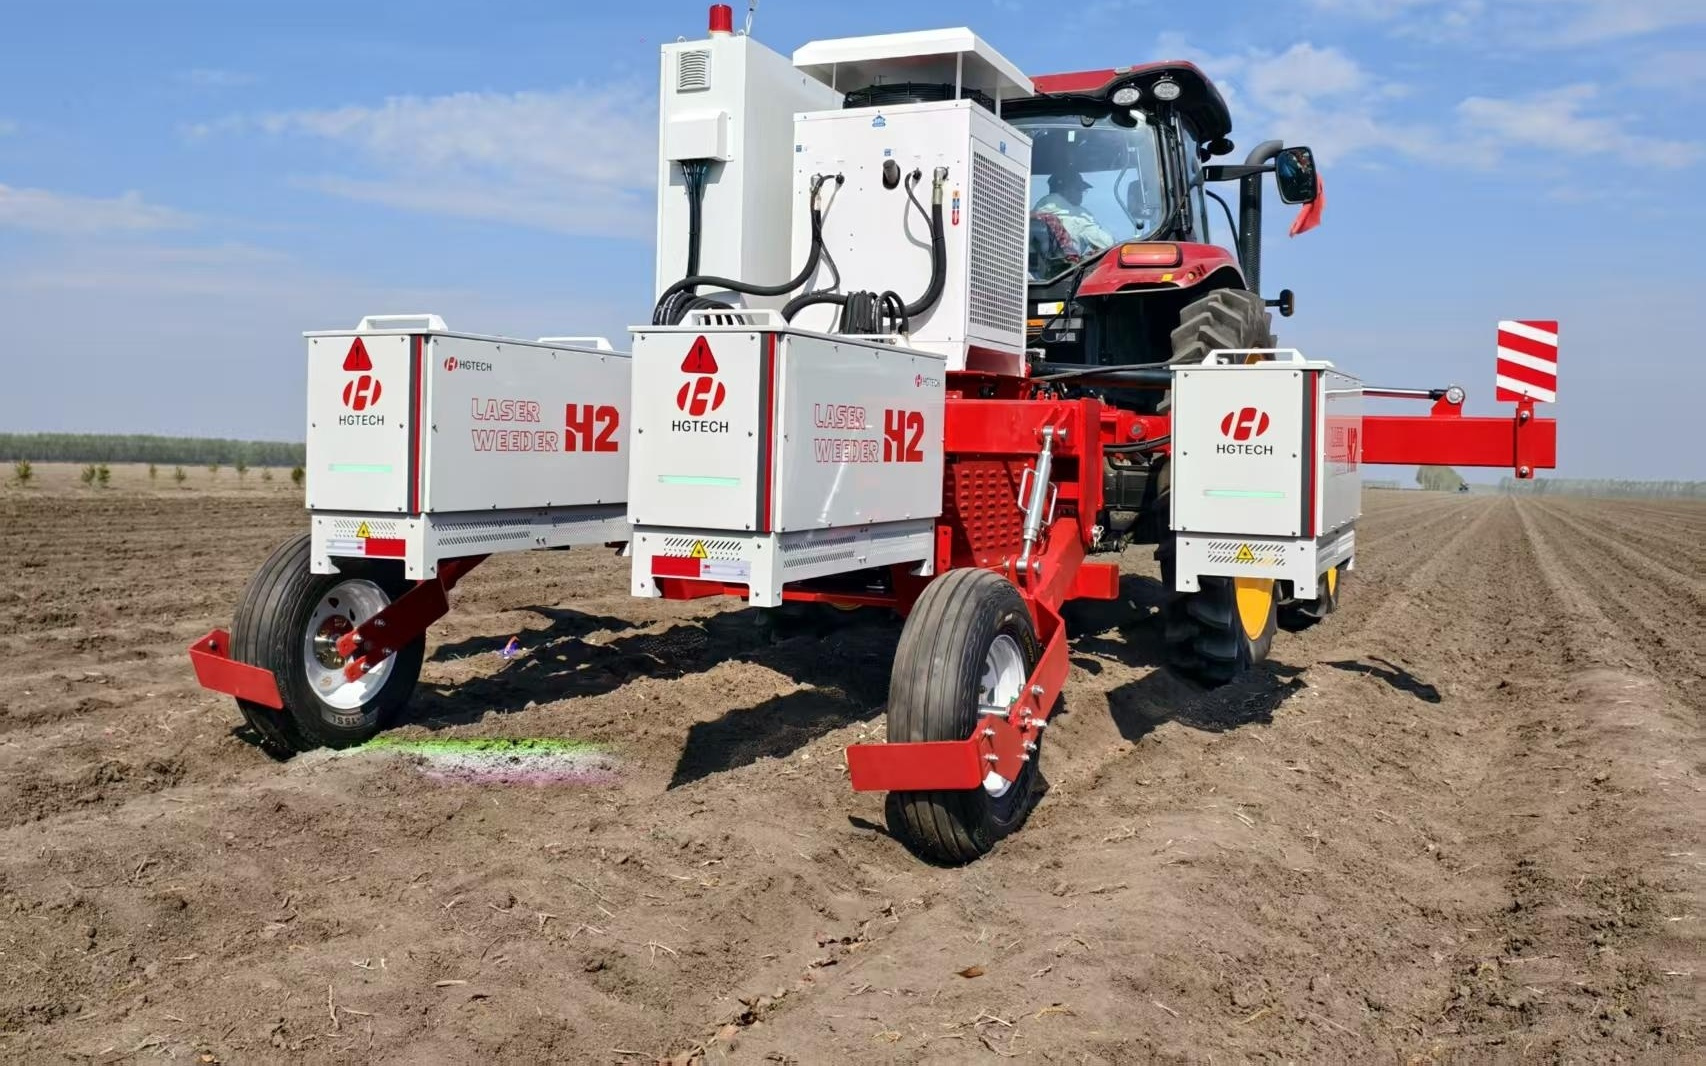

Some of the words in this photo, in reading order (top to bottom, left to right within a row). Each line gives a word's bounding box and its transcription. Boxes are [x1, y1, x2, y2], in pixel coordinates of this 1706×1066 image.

[459, 360, 493, 372] HGTECH
[338, 414, 385, 426] HGTECH
[471, 398, 541, 423] LASER
[814, 403, 867, 430] LASER
[564, 403, 620, 453] H2
[671, 420, 730, 433] HGTECH
[883, 409, 925, 463] H2
[471, 429, 560, 453] WEEDER
[813, 438, 880, 463] WEEDER
[1216, 444, 1274, 456] HGTECH
